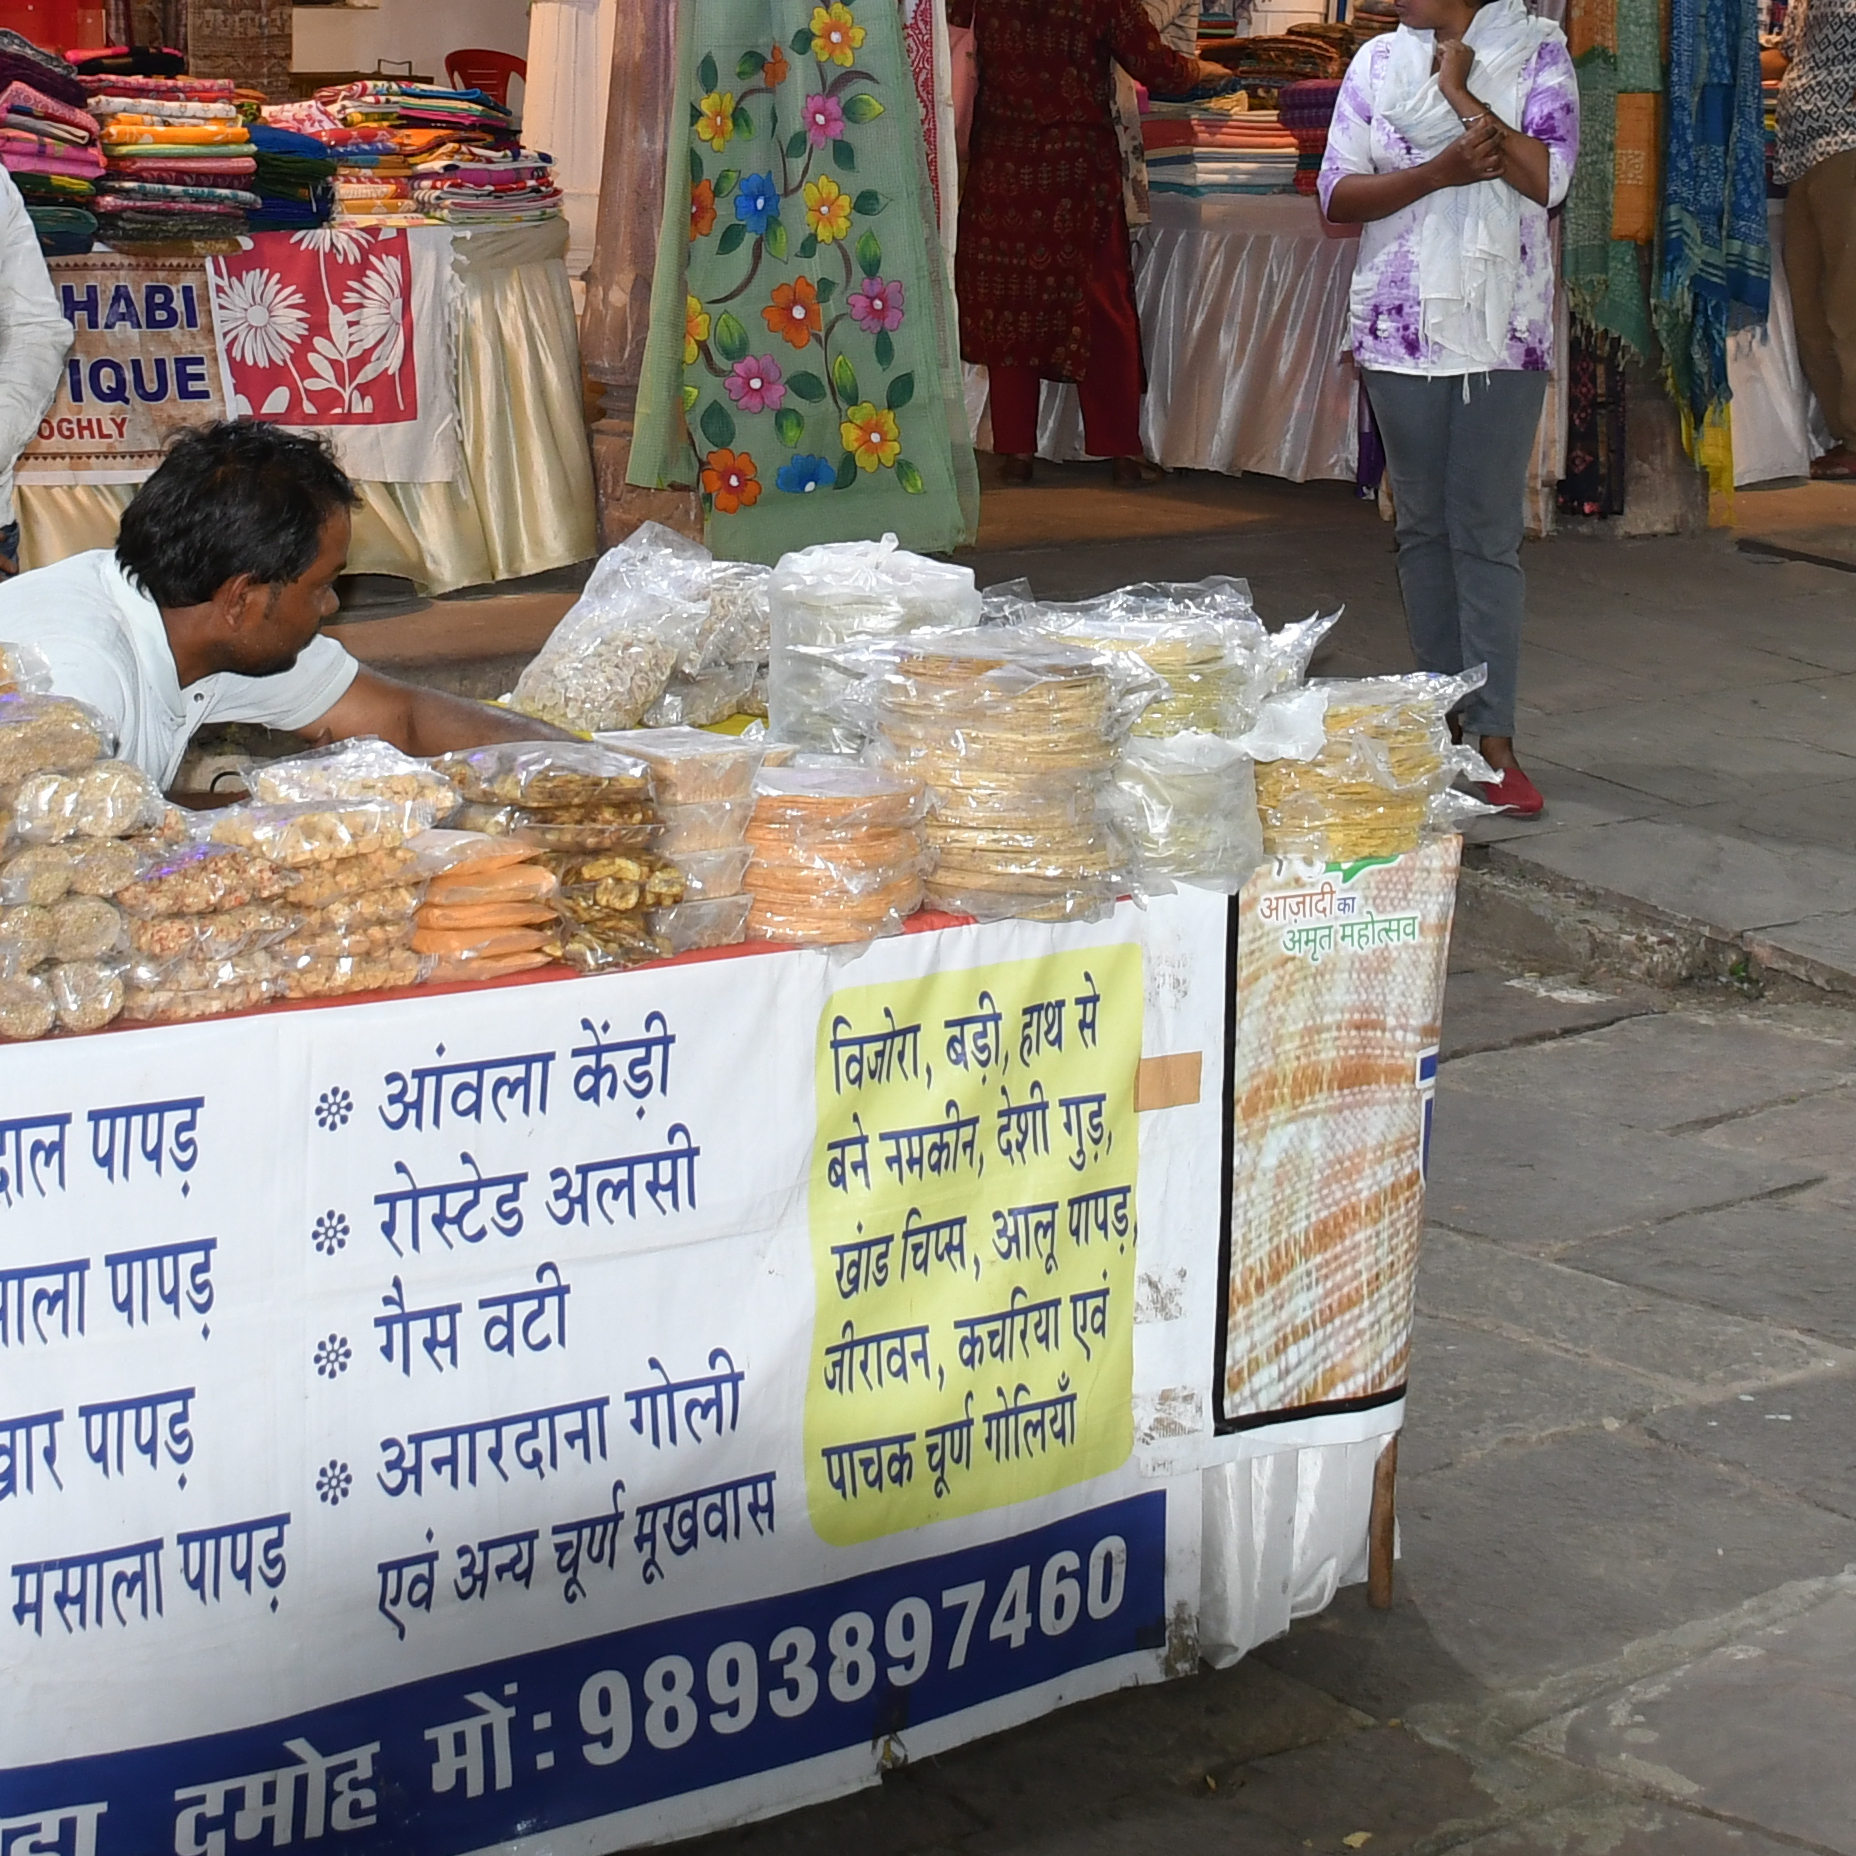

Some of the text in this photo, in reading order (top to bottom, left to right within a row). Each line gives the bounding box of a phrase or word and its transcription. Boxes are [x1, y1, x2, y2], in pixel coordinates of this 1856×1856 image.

[1260, 881, 1357, 924] आज़ादी का
[1282, 911, 1418, 961] अमृत महोत्सव
[378, 1009, 677, 1134] आंवला केंड़ी
[830, 971, 1101, 1096] विजोरा, बड़ी, हाथ से
[87, 1096, 205, 1199] पापड़
[373, 1122, 701, 1259] रोस्टेड अलसी
[827, 1079, 1113, 1196] बने नमकीन, देशी गुड़,
[104, 1237, 218, 1343] पापड़
[831, 1184, 1138, 1301] खांड चिप्स, आलू पापड़,
[375, 1260, 571, 1380] गैस वटी
[823, 1268, 1111, 1397] जीरावन, कचरिया एवं
[78, 1386, 196, 1491] पापड़
[377, 1346, 745, 1499] अनारदाना गोली
[821, 1369, 1078, 1503] पाचक चूर्ण गोलियाँ
[12, 1538, 164, 1639] मसाला
[177, 1512, 291, 1614] पापड़
[377, 1469, 777, 1642] एवं अन्य चूर्ण मूखवास
[174, 1737, 380, 1856] दमोह
[578, 1535, 1127, 1767] 9893897460
